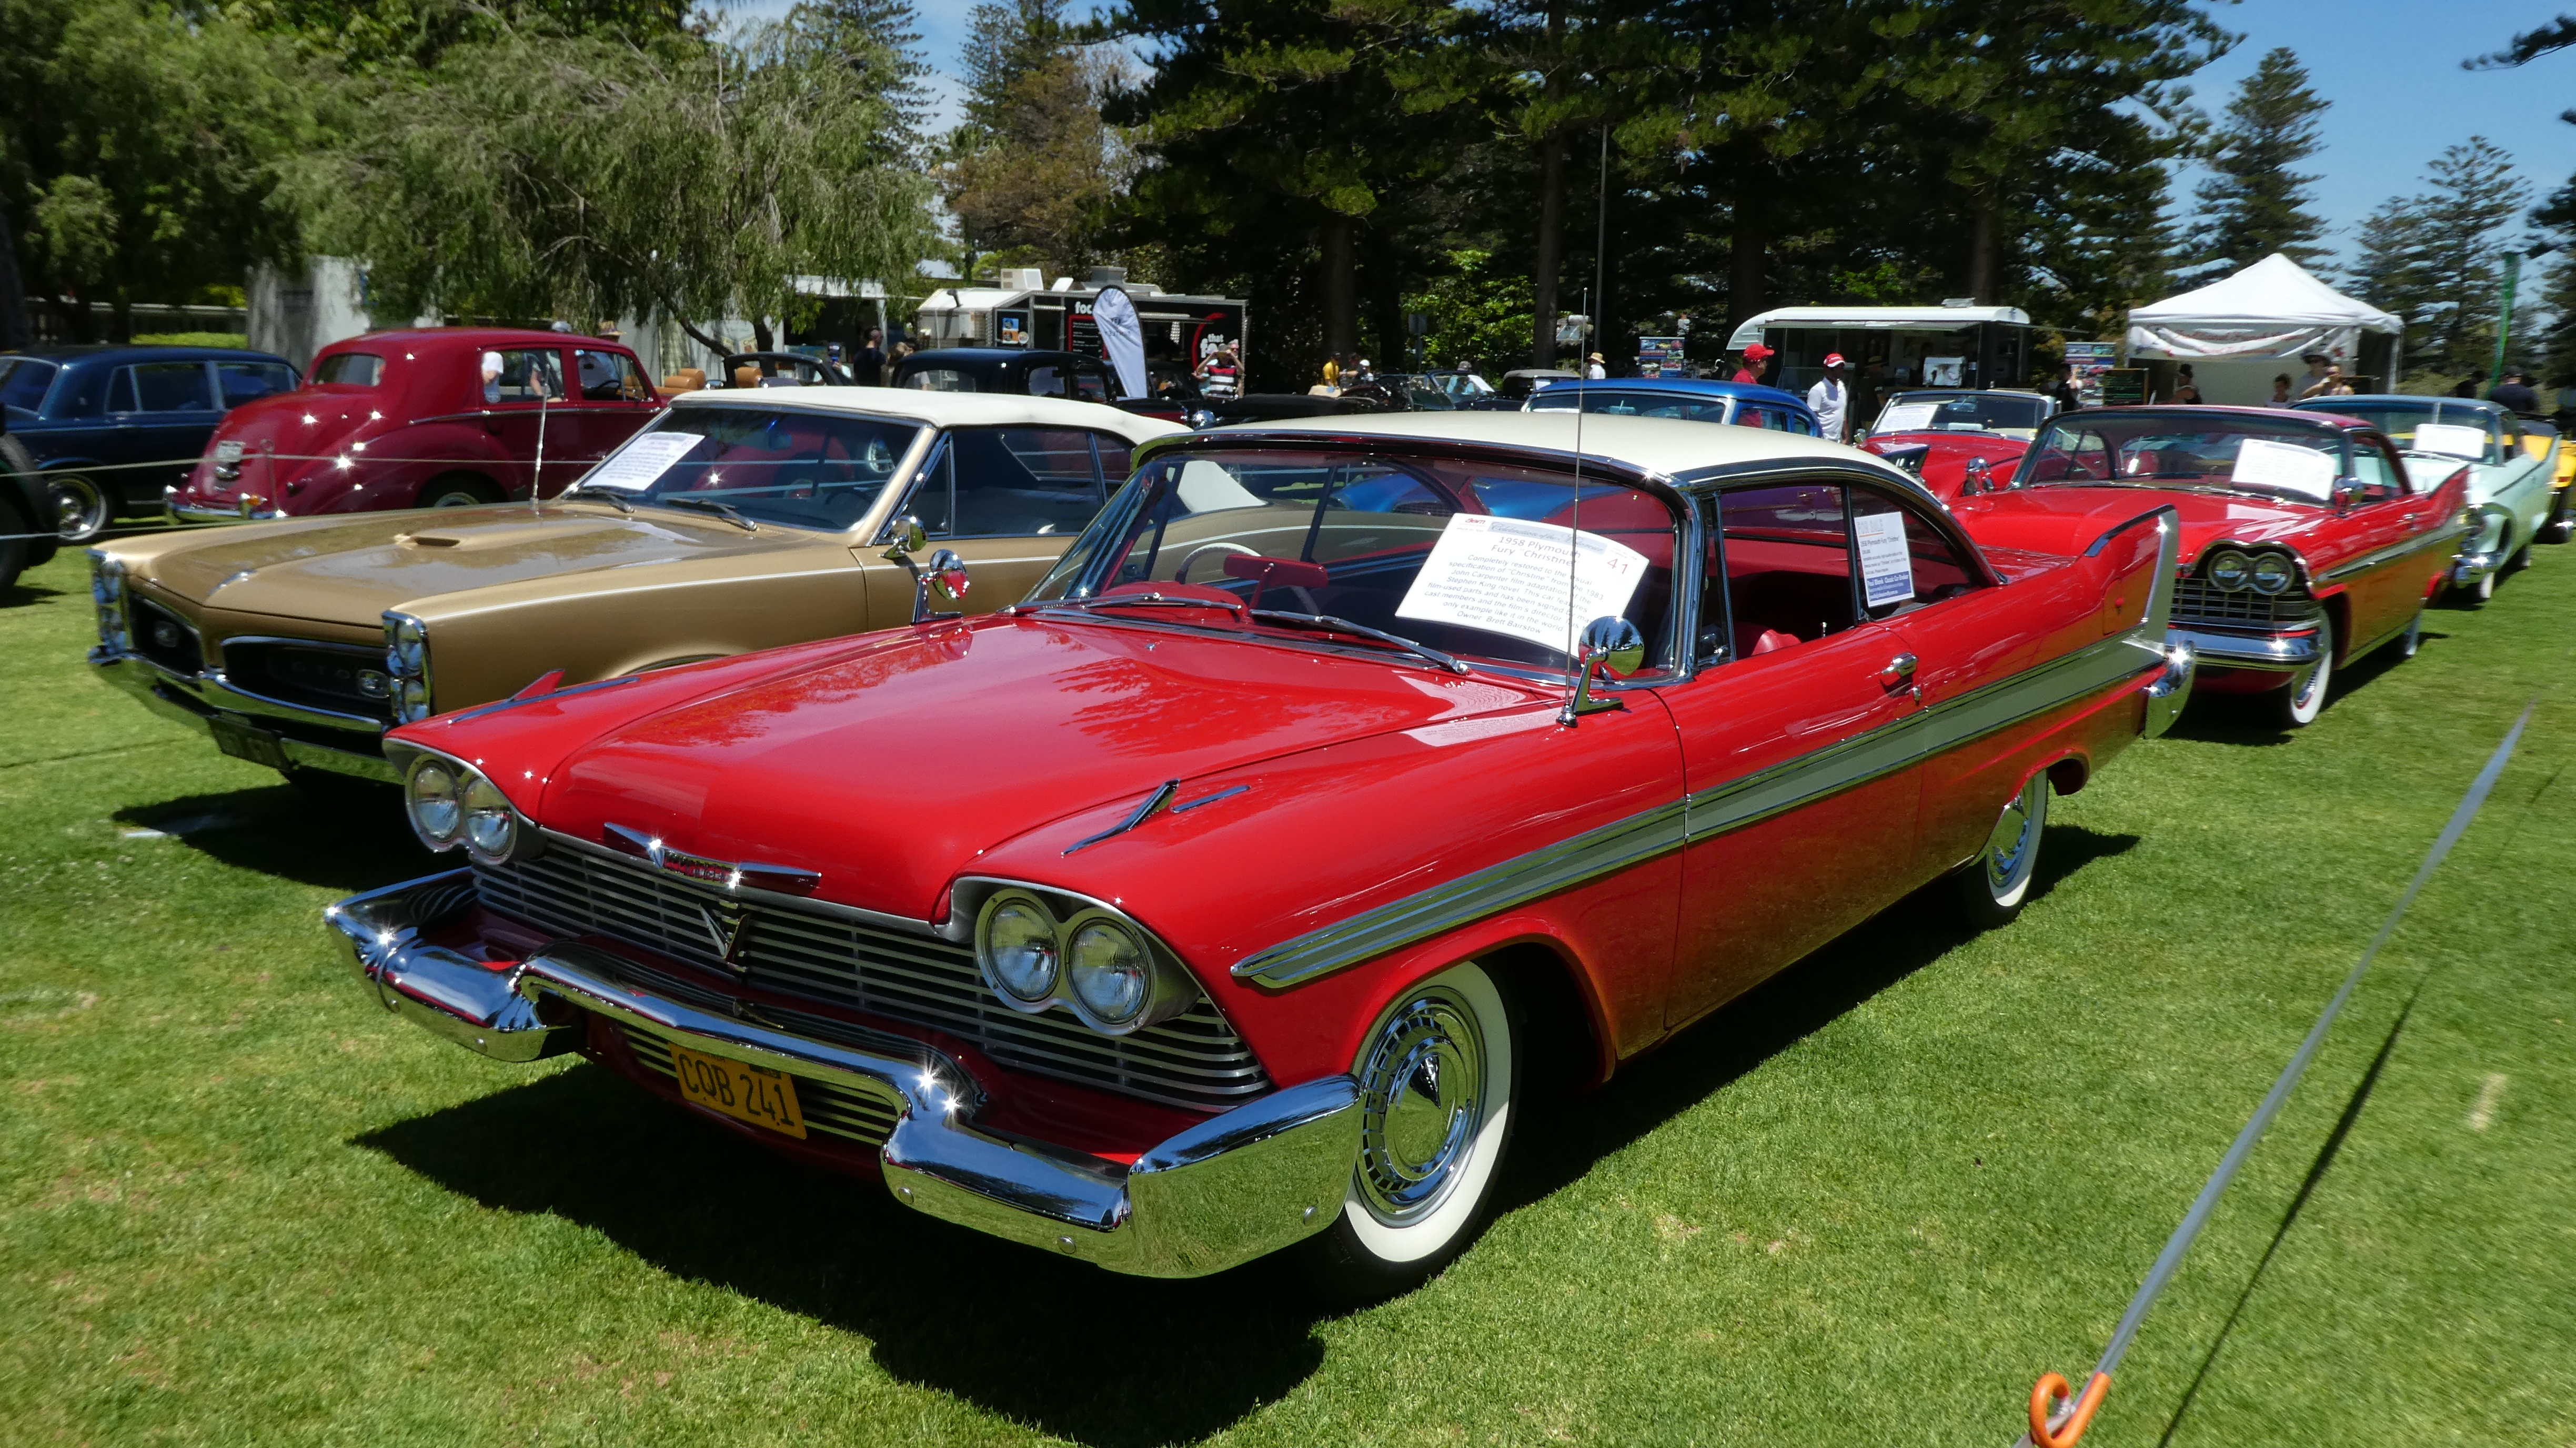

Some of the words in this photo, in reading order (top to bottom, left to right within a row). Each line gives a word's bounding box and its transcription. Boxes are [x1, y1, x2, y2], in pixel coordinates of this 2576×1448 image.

[1208, 333, 1224, 343] that
[1491, 521, 1537, 536] Celebration
[1491, 545, 1515, 556] Fury
[1498, 537, 1526, 546] 1958
[1527, 540, 1581, 558] Plymouth
[1468, 554, 1509, 566] Completely
[1511, 561, 1544, 572] restored
[1570, 576, 1593, 586] isual
[1607, 558, 1628, 575] 41
[1448, 561, 1495, 572] specification
[1551, 578, 1569, 587] from
[1586, 589, 1604, 600] 1983
[1472, 571, 1508, 582] Carpenter
[1526, 581, 1567, 596] adaptation
[1579, 596, 1592, 605] the
[1427, 581, 1462, 592] film-used
[1516, 596, 1535, 605] been
[1537, 601, 1564, 614] signed
[1443, 601, 1460, 609] only
[1461, 604, 1493, 614] example
[1446, 576, 1477, 585] Stephen
[1478, 580, 1497, 590] King
[1524, 588, 1540, 598] This
[1557, 597, 1588, 614] feaures
[1442, 593, 1475, 602] members
[1566, 618, 1579, 629] Tis
[1486, 616, 1505, 625] Brett
[1507, 620, 1542, 634] Bairstow
[739, 1073, 796, 1127] 241
